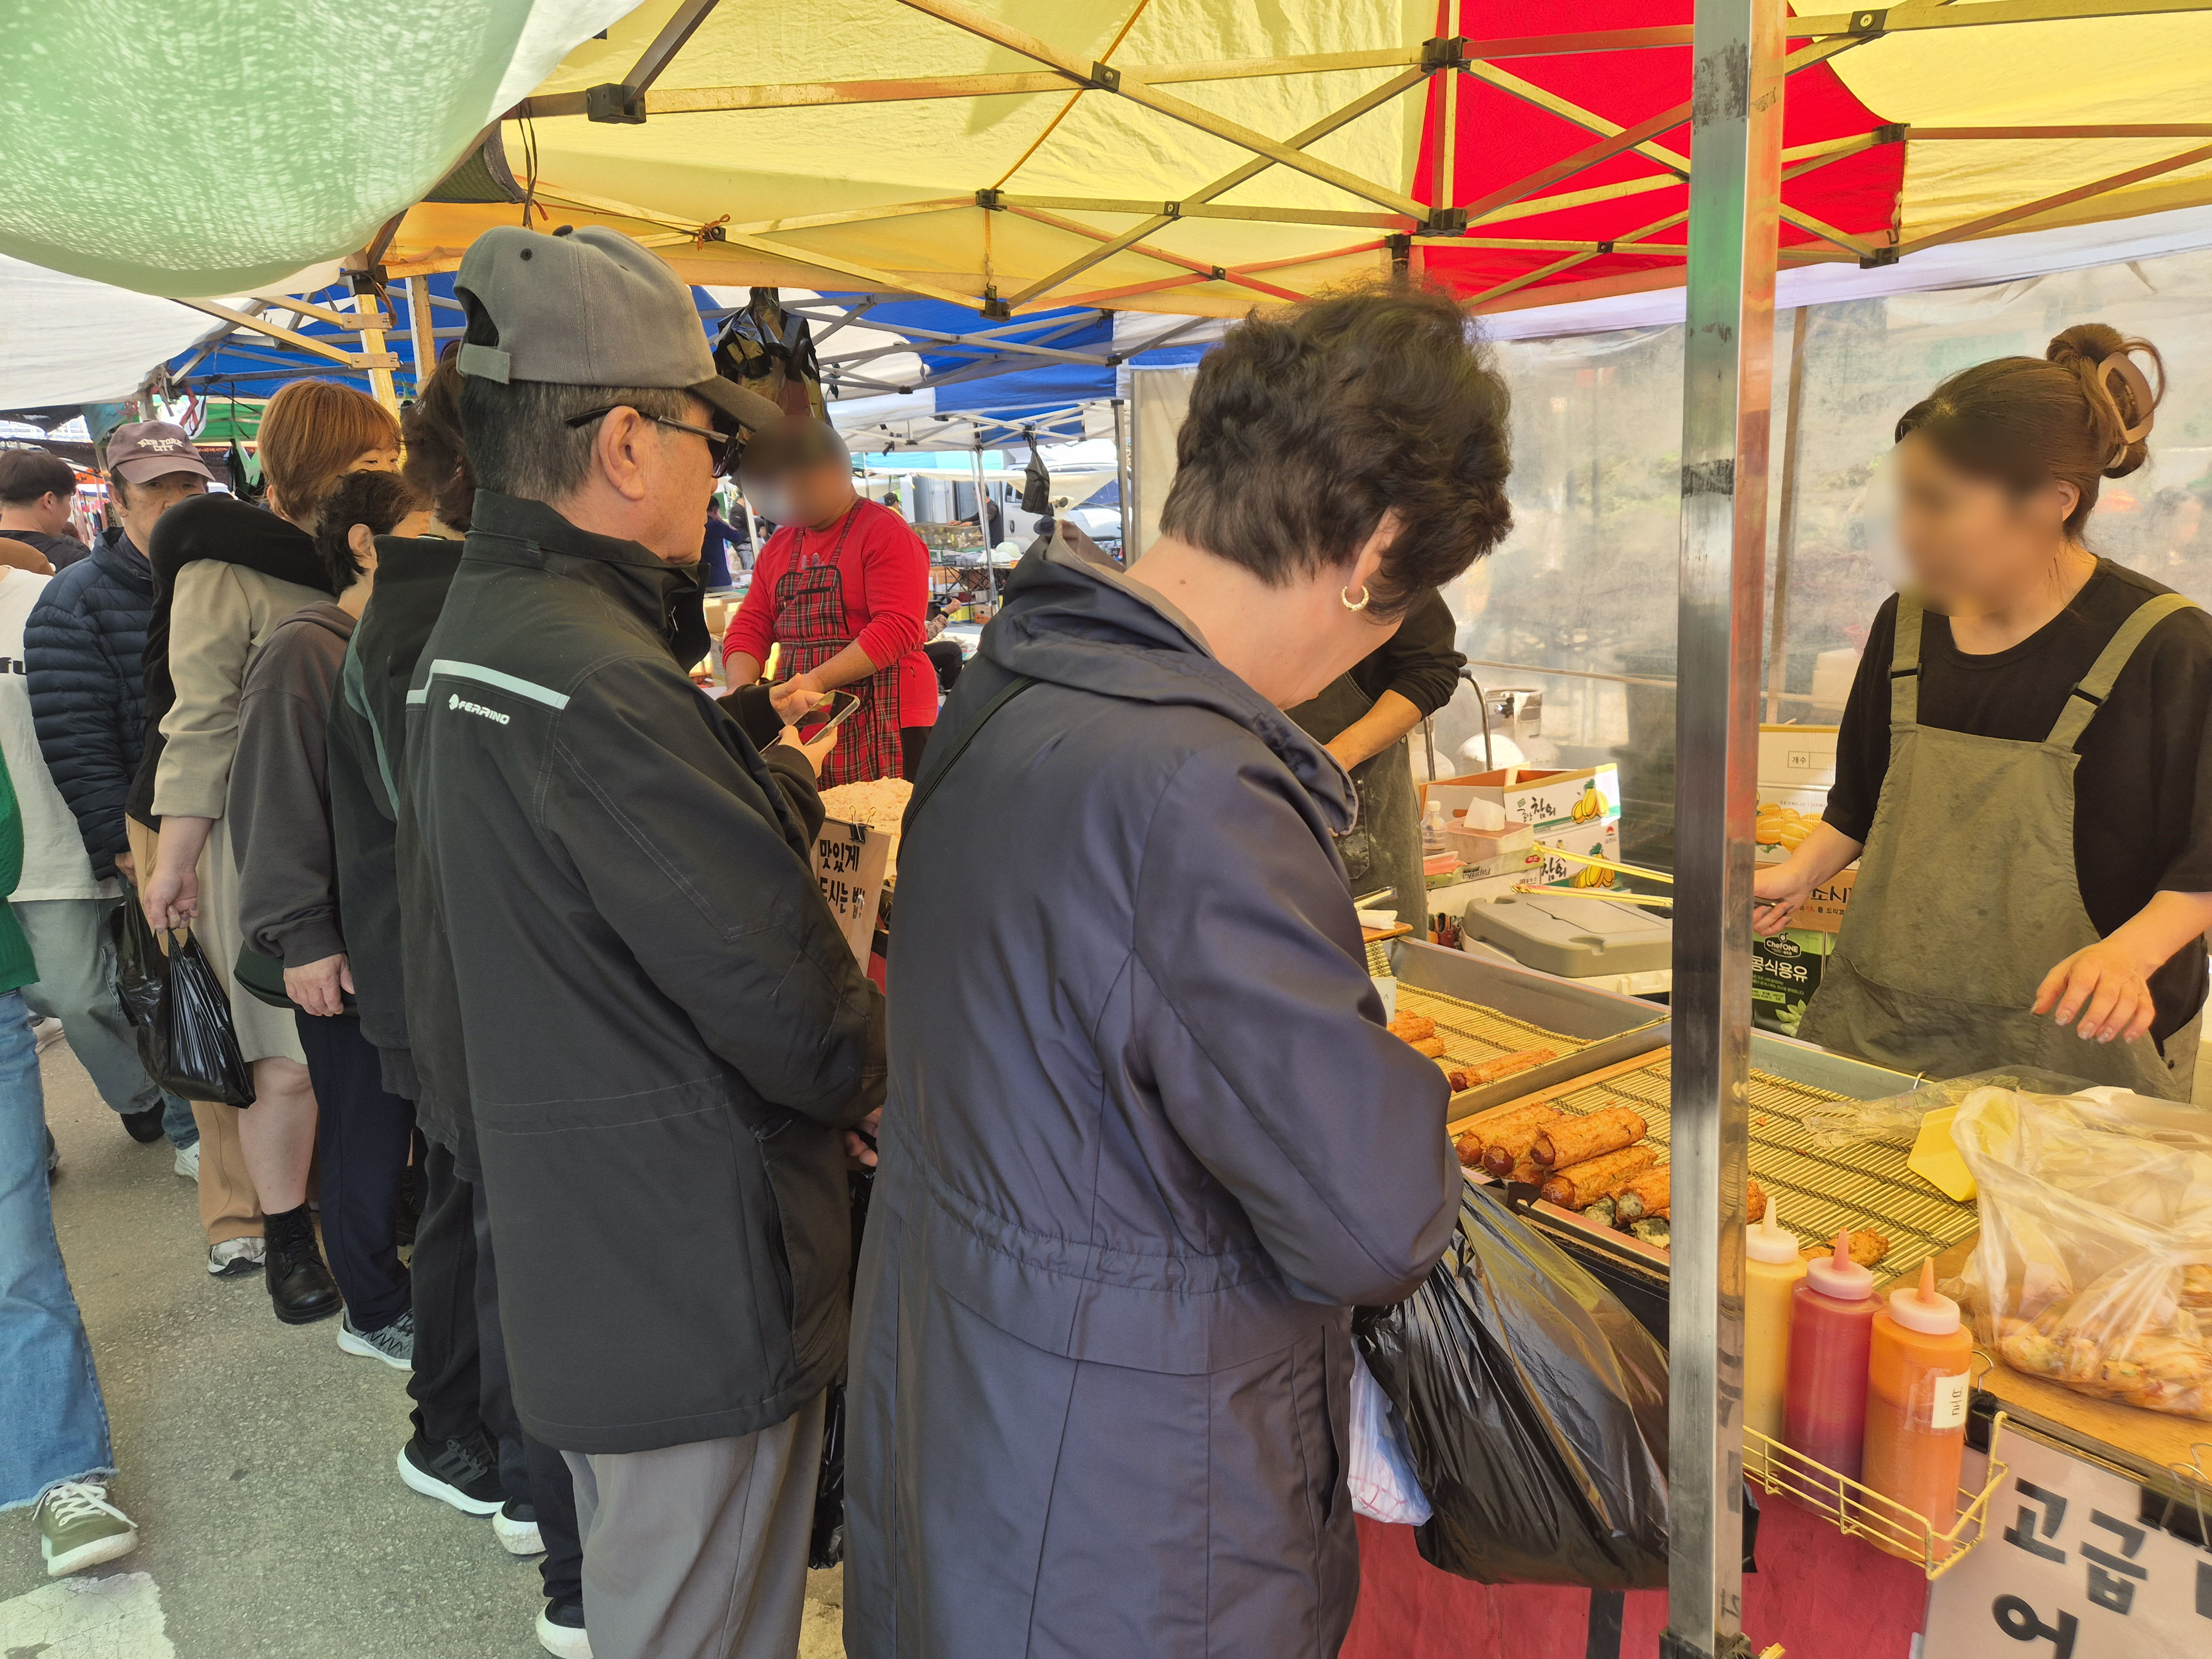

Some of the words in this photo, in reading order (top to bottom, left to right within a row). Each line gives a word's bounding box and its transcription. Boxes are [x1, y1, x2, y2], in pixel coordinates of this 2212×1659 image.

[137, 439, 158, 448] NEW
[158, 437, 183, 447] YORK
[458, 700, 510, 725] FERRINO
[1792, 756, 1807, 764] 개수
[1531, 796, 1556, 820] 참외
[820, 839, 860, 873] 맛있게
[1462, 868, 1491, 880] Paprika
[1810, 885, 1851, 903] 소시
[1766, 940, 1798, 953] ChefONE
[2003, 1477, 2148, 1616] 고급
